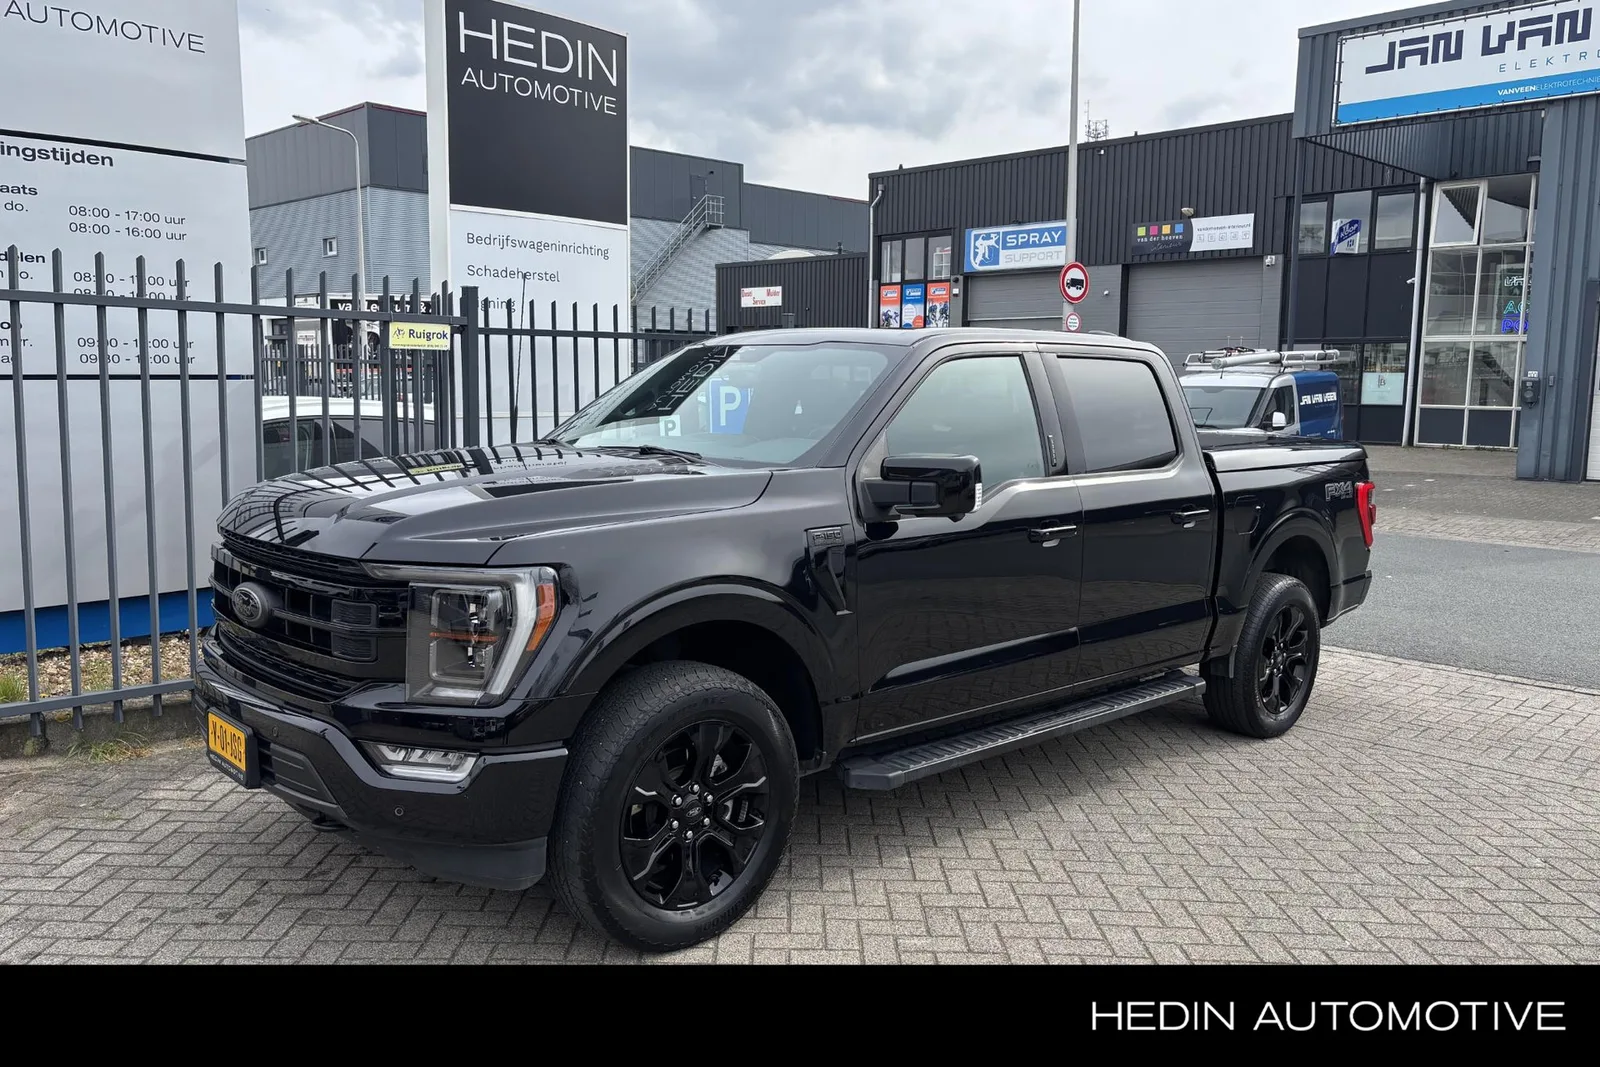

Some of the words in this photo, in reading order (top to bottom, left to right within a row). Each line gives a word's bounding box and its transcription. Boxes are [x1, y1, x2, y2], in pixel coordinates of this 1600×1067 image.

[4, 0, 205, 53] AUTOMOTIVE
[458, 11, 617, 87] HEDIN
[1364, 29, 1464, 75] JAN
[1480, 7, 1593, 57] VAN
[461, 67, 617, 115] AUTOMOTIVE
[68, 205, 110, 219] 08:00
[124, 210, 160, 223] 17:00
[164, 215, 186, 225] uur
[68, 222, 110, 235] 08:00
[124, 226, 162, 239] 16:00
[165, 231, 187, 241] uur
[1006, 230, 1062, 246] SPRAY
[466, 232, 610, 260] Bedrijfswageninrichting
[1005, 250, 1063, 263] SUPPORT
[73, 271, 115, 283] 08:0
[467, 264, 560, 283] Schadeherstel
[408, 328, 448, 342] Ruigrok
[719, 386, 742, 426] P
[663, 420, 676, 436] P
[1325, 481, 1353, 501] FX4
